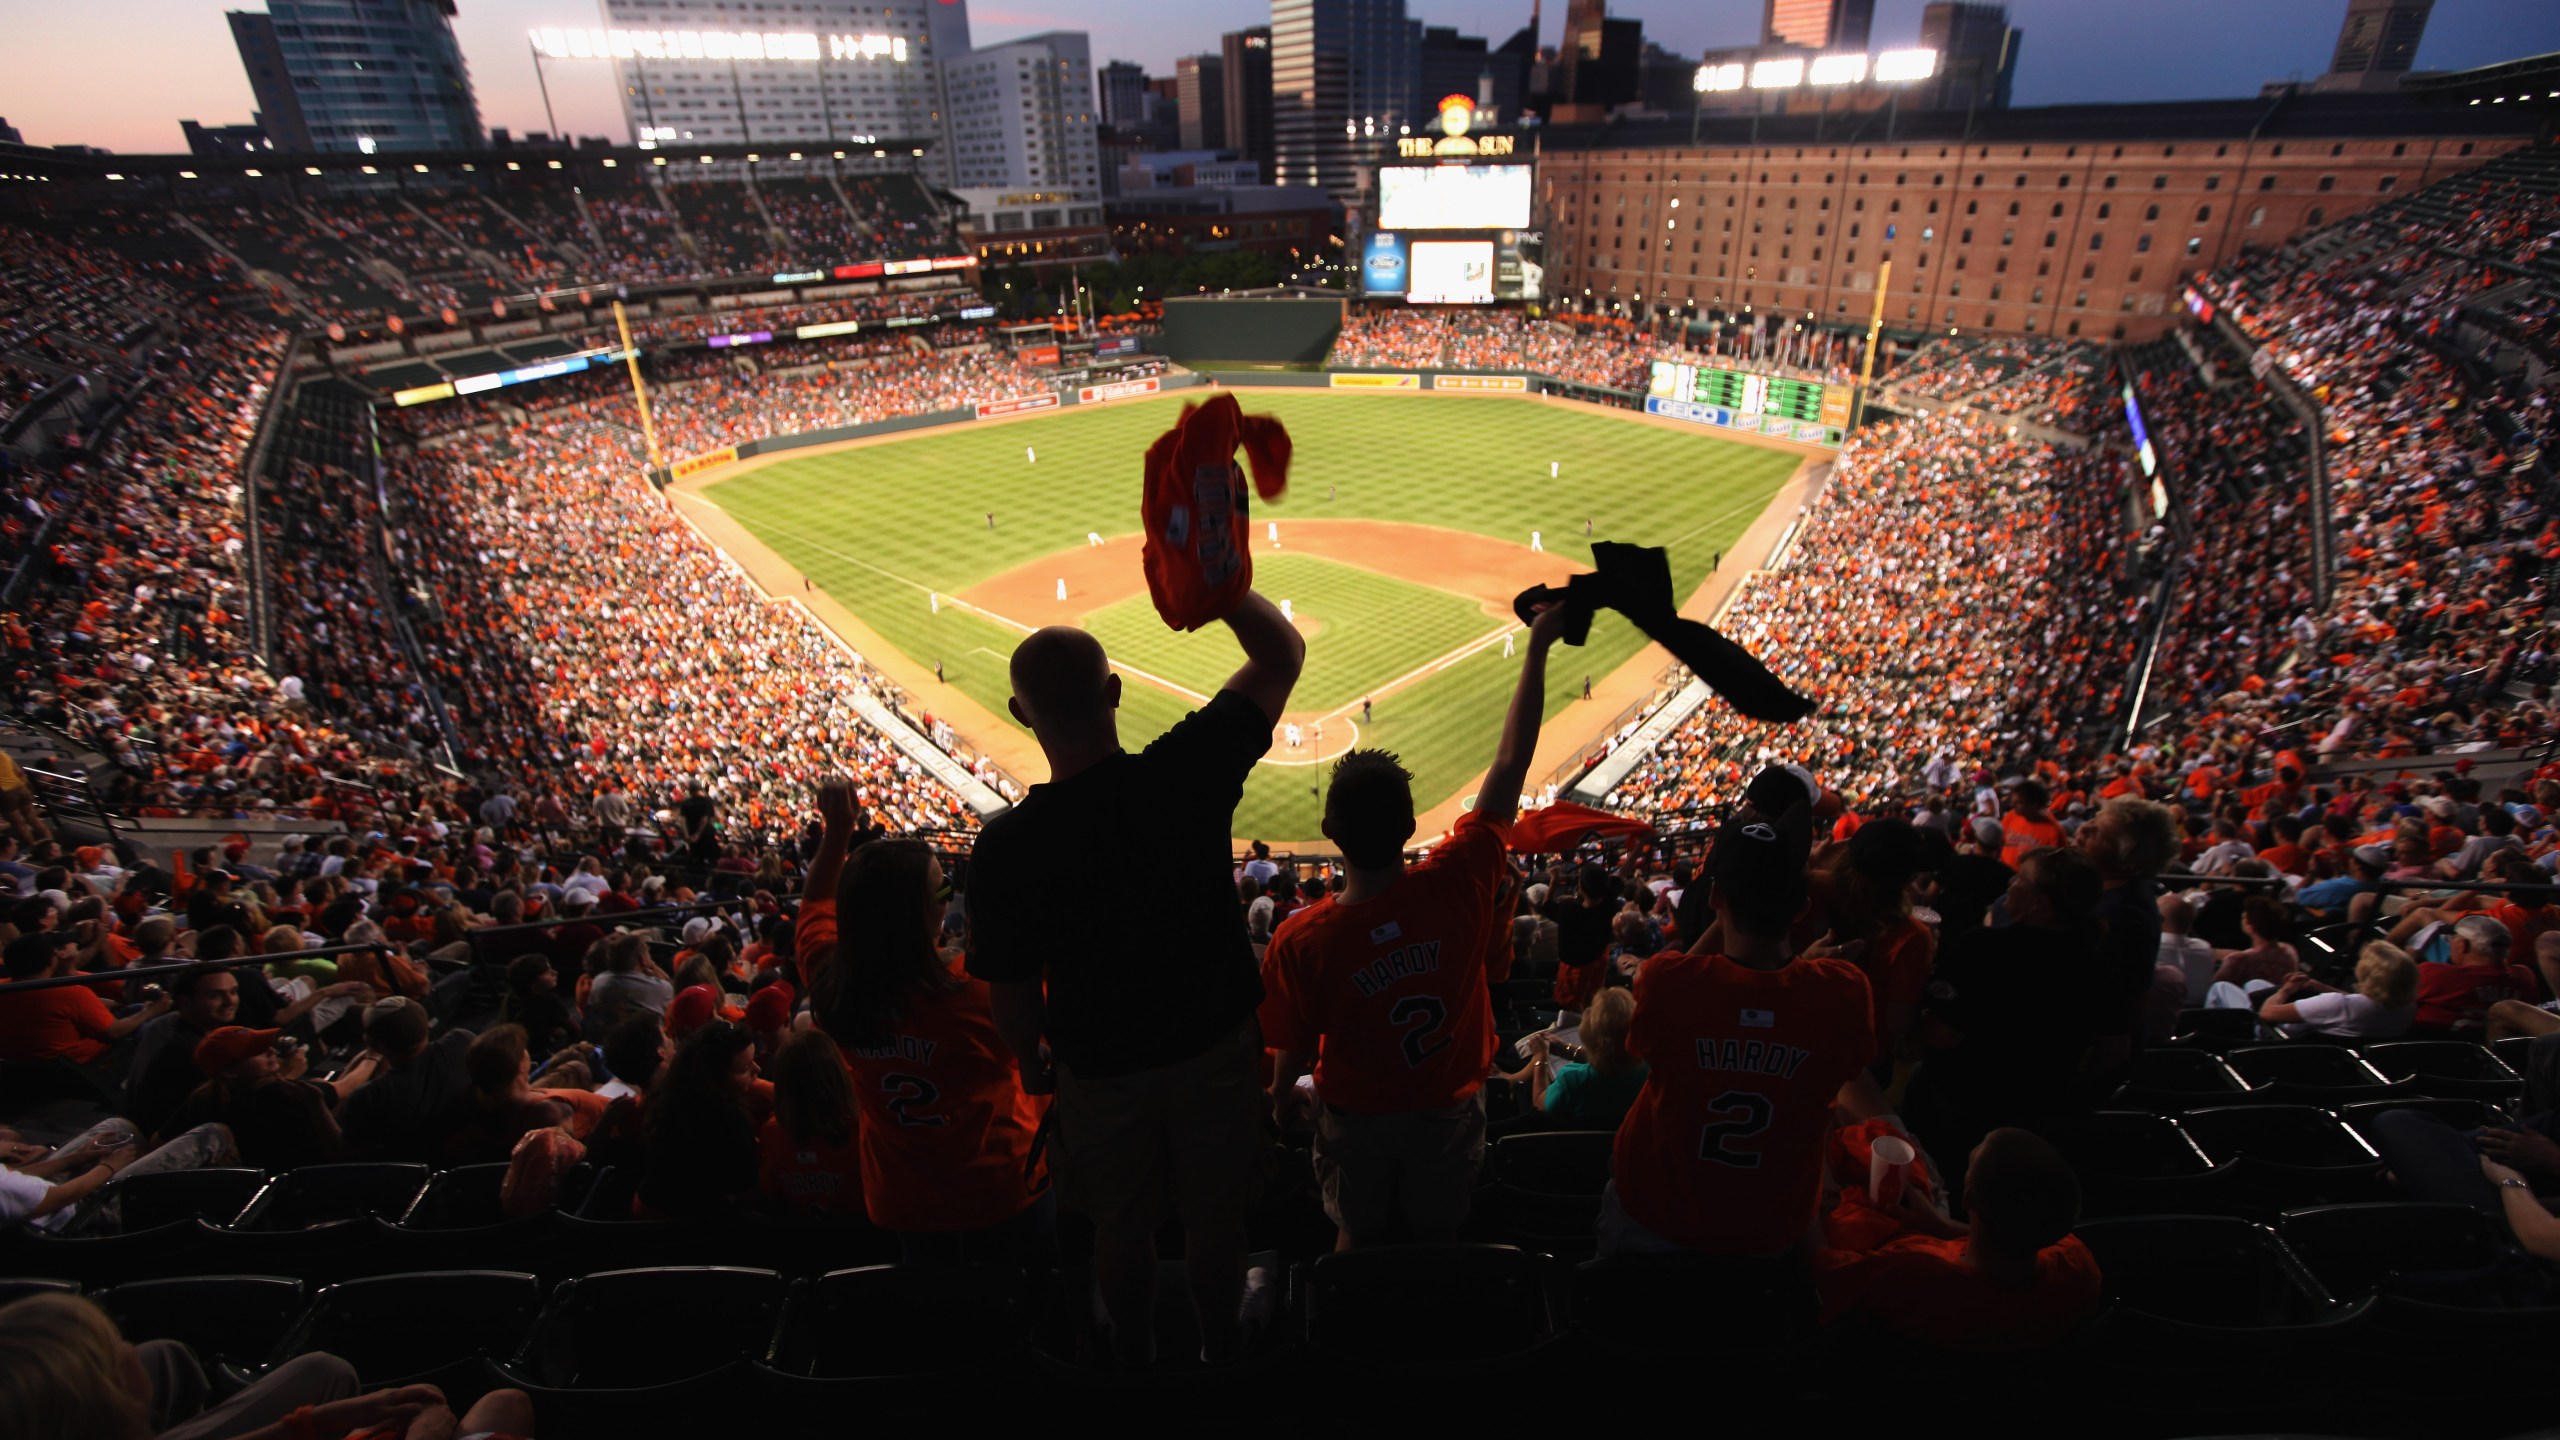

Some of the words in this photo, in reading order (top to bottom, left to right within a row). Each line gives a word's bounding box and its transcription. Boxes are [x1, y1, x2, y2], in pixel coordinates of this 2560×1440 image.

[1397, 138, 1433, 157] THE
[1479, 136, 1514, 155] SUN
[1516, 232, 1544, 246] PNC
[1104, 385, 1125, 397] State
[1126, 383, 1147, 394] Farm
[1351, 940, 1441, 998] HARDY
[1389, 994, 1454, 1069] 2
[1695, 1038, 1810, 1079] HARDY
[881, 1071, 947, 1127] 2
[1698, 1090, 1774, 1169] 2
